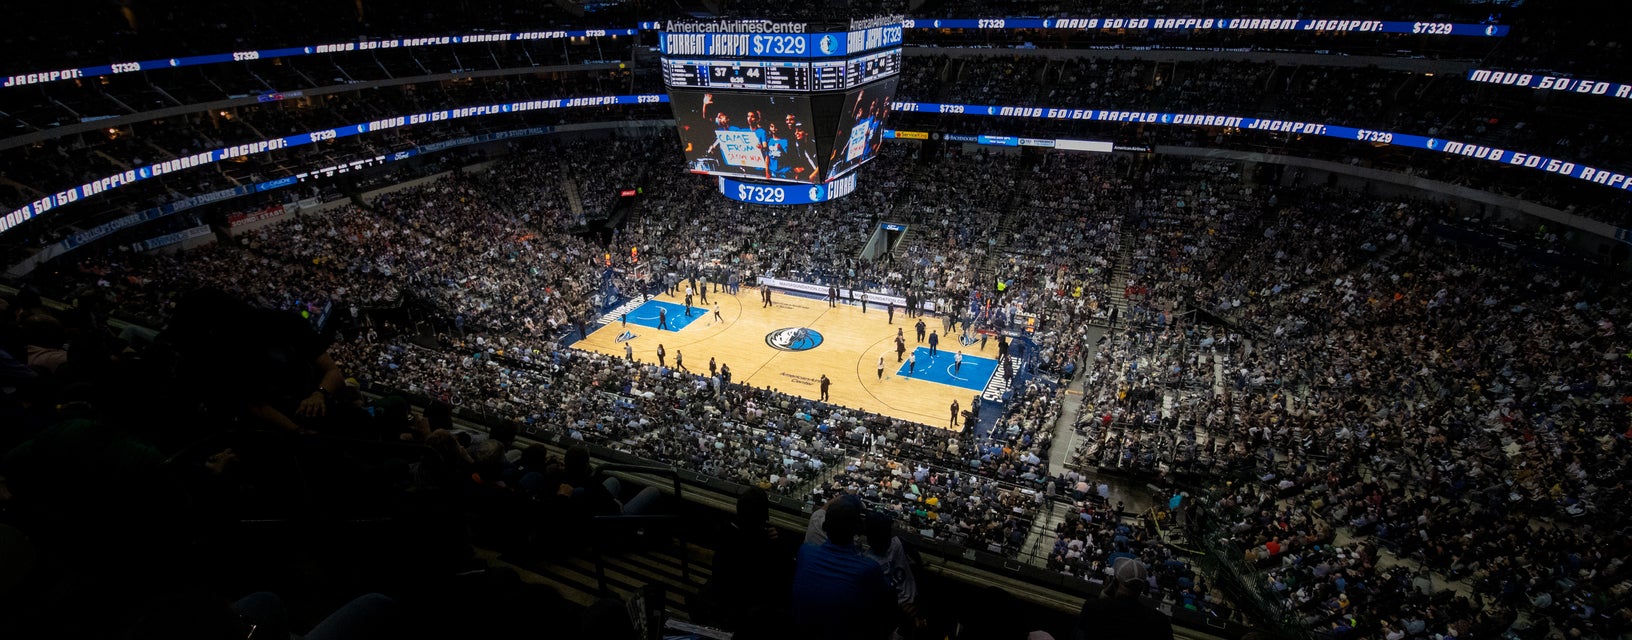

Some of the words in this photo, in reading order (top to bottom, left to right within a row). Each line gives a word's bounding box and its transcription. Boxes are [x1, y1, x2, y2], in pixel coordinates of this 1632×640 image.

[978, 19, 1004, 29] $7329
[1056, 19, 1098, 29] MAVS
[1103, 19, 1148, 29] 50/50
[1154, 19, 1212, 29] RAFFLE
[1229, 19, 1299, 30] CURRENT
[1304, 20, 1383, 32] JACKPOT:
[1413, 22, 1452, 35] $7329
[462, 34, 511, 43] CURRENT
[516, 31, 567, 39] JACKPOT:
[882, 26, 902, 45] $7329
[316, 43, 354, 53] MAVS
[359, 39, 398, 50] 50/50
[403, 37, 449, 46] RAFFLE
[667, 34, 705, 55] CURRENT
[709, 35, 750, 56] JACKPOT
[753, 34, 806, 55] $7329
[233, 51, 259, 61] $7329
[111, 62, 140, 74] $7329
[715, 68, 727, 76] 37
[747, 69, 760, 77] 44
[4, 68, 83, 87] JACKPOT:
[1472, 70, 1530, 86] MAVS
[1540, 77, 1610, 95] 50/50
[511, 99, 562, 112] CURRENT
[567, 96, 618, 107] JACKPOT:
[637, 95, 660, 103] $7329
[940, 105, 964, 114] $7329
[1000, 107, 1042, 117] MAVS
[1048, 108, 1092, 120] 50/50
[1098, 111, 1157, 123] RAFFLE
[369, 117, 405, 131] MAVS
[410, 110, 448, 124] 50/50
[452, 105, 499, 118] RAFFLE
[1173, 114, 1243, 127] CURRENT
[1248, 119, 1326, 135] JACKPOT:
[310, 130, 337, 141] $7329
[719, 134, 749, 143] CAME
[1357, 130, 1392, 143] $7329
[152, 151, 214, 177] CURRENT
[219, 138, 288, 159] JACKPOT:
[1443, 141, 1504, 161] MAVS
[1510, 153, 1574, 174] 50/50
[33, 188, 78, 214] 50/50
[82, 169, 136, 198] RAFFLE
[739, 184, 785, 203] $7329
